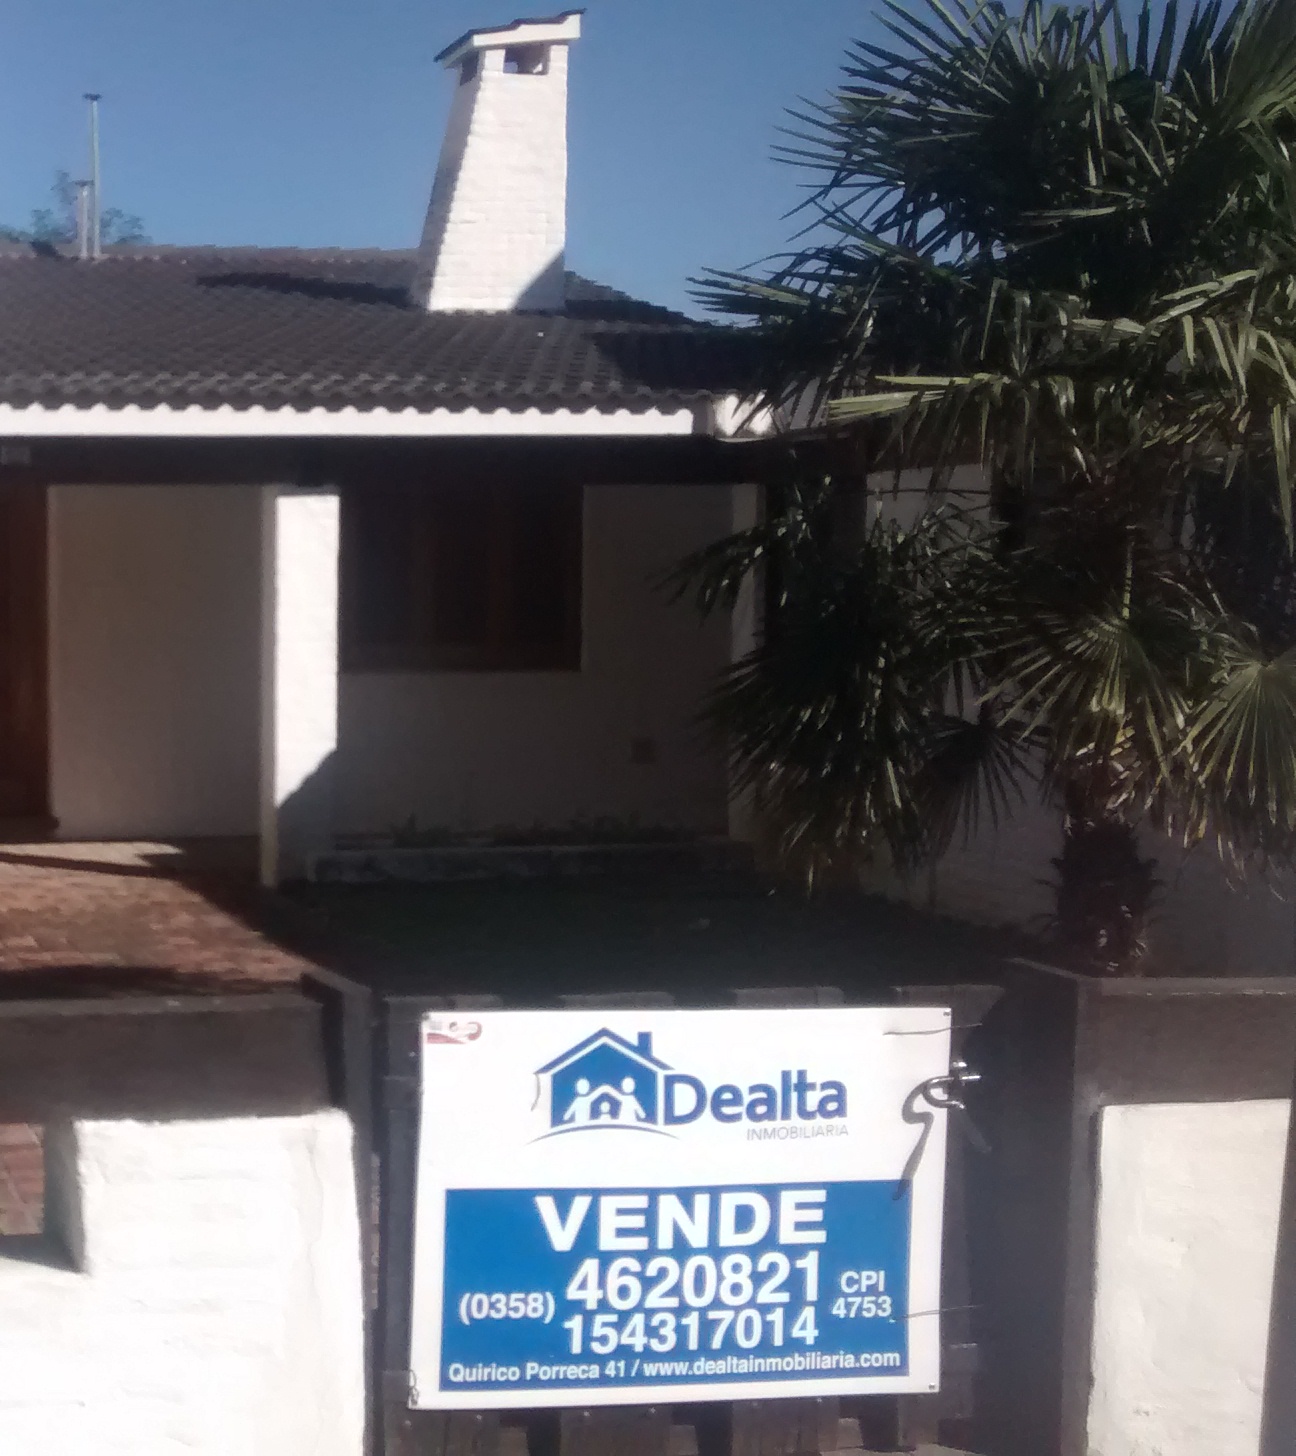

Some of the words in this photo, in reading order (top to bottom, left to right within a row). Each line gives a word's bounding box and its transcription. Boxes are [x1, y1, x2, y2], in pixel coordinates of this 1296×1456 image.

[663, 1070, 848, 1126] Dealta
[746, 1124, 849, 1142] INMOBILIARIA
[535, 1189, 827, 1251] VENDE
[566, 1251, 819, 1310] 4620821
[840, 1270, 886, 1293] CPI
[459, 1292, 556, 1325] (0358)
[831, 1297, 892, 1318] 4753
[563, 1306, 819, 1354] 154317014
[449, 1362, 520, 1383] Quirico
[526, 1359, 600, 1380] Porreca
[605, 1357, 626, 1377] 41
[643, 1350, 901, 1376] www.dealtainmobiliaria.com
